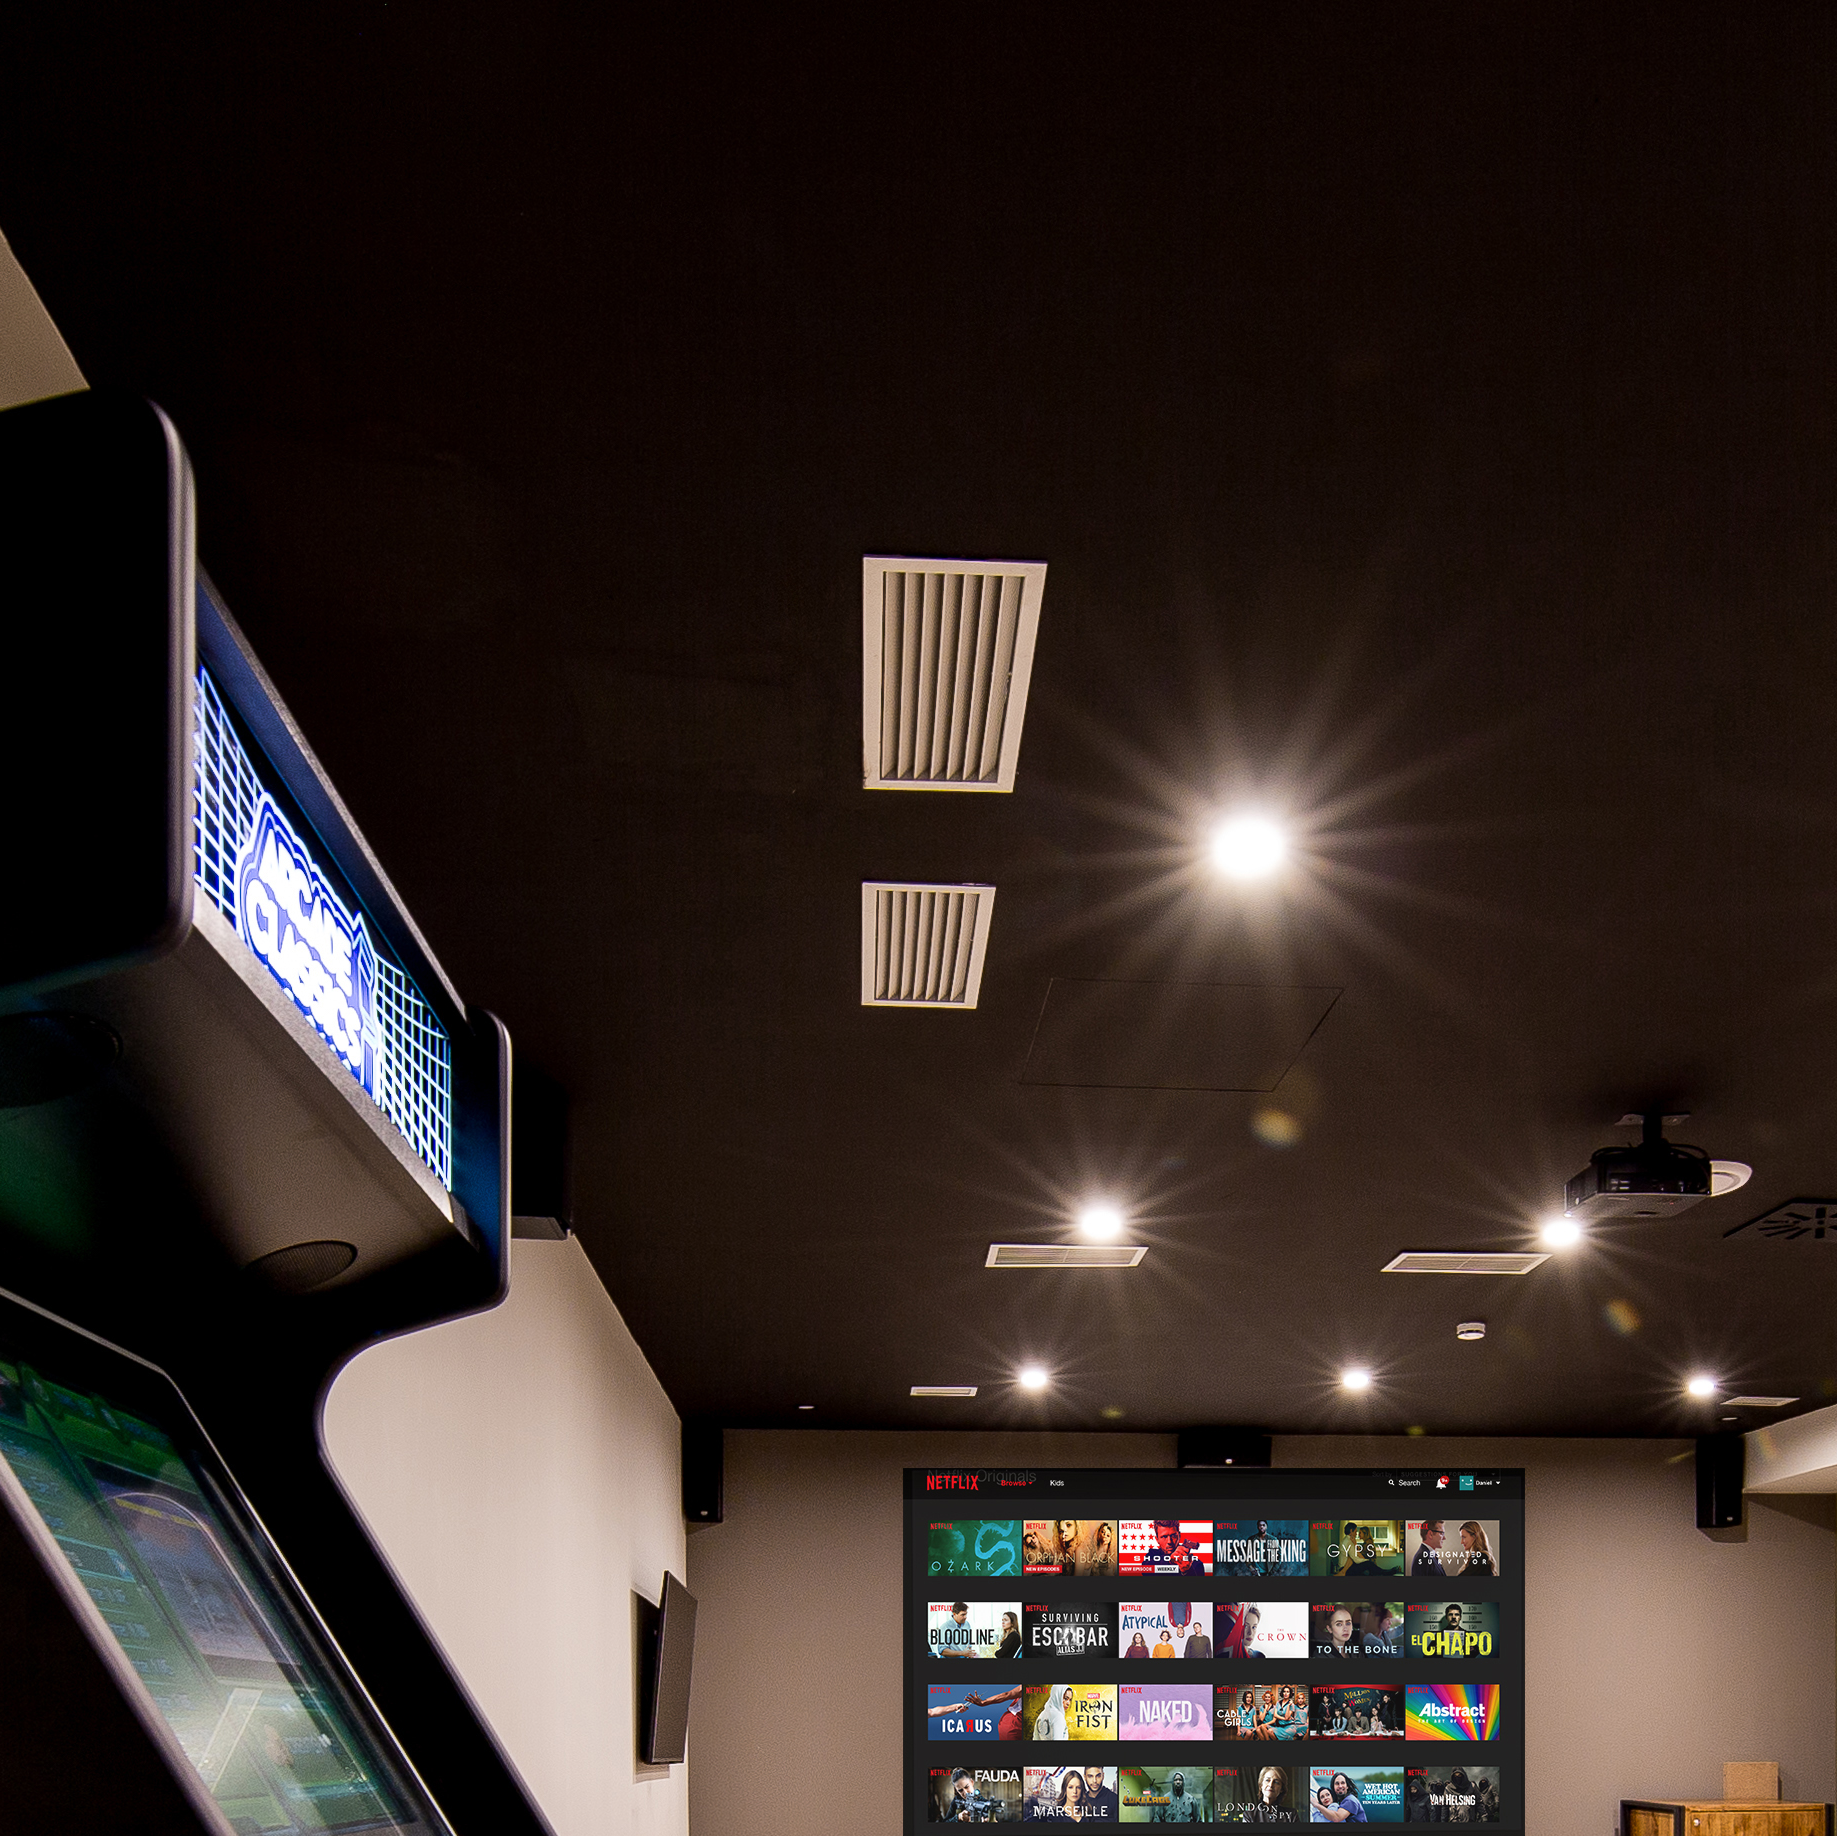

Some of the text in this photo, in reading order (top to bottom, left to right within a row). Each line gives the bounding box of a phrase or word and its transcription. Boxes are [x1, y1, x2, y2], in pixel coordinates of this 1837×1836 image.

[259, 828, 352, 996] ARCADE
[245, 878, 362, 1067] CLASSICS
[927, 1475, 979, 1491] NETFLIX
[930, 1522, 953, 1530] NETFLIX
[1026, 1522, 1046, 1530] NETFLIX
[1121, 1522, 1142, 1530] NETFLIX
[1217, 1522, 1238, 1530] NETFLIX
[1313, 1522, 1334, 1530] NETFLIX
[1408, 1522, 1428, 1530] NETFLIX
[1217, 1540, 1266, 1563] MESSAGE
[1280, 1540, 1306, 1563] KING
[1327, 1544, 1389, 1558] GYPSY
[1026, 1552, 1115, 1564] ORPHAN BLACK
[1267, 1550, 1279, 1563] THE
[930, 1604, 952, 1612] NETFLIX
[1026, 1604, 1048, 1612] NETFLIX
[1121, 1604, 1142, 1612] NETFLIX
[1217, 1604, 1239, 1612] NETFLIX
[1313, 1604, 1335, 1612] NETFLIX
[1408, 1604, 1428, 1612] NETFLIX
[1042, 1614, 1099, 1622] SURVIVING
[1122, 1614, 1168, 1630] ATYPICAL
[930, 1629, 995, 1646] BLOODLINE
[1257, 1633, 1306, 1641] CROWN
[1412, 1631, 1492, 1656] EL CHAPO
[1317, 1646, 1398, 1654] TO THE BONE
[930, 1686, 951, 1694] NETFLIX
[1026, 1686, 1048, 1694] NETFLIX
[1121, 1686, 1142, 1694] NETFLIX
[1217, 1686, 1238, 1694] NETFLIX
[1313, 1686, 1335, 1694] NETFLIX
[1408, 1686, 1428, 1694] NETFLIX
[1075, 1700, 1113, 1713] IRON
[1419, 1703, 1486, 1717] Abstract
[1140, 1700, 1192, 1723] NAKED
[1217, 1710, 1246, 1718] CABLE
[1076, 1715, 1112, 1729] FIST
[1224, 1718, 1252, 1726] GIRLS
[974, 1770, 1020, 1782] FAUDA
[1430, 1794, 1476, 1806] VAN HELSING
[1217, 1802, 1278, 1812] LONDON
[1033, 1805, 1108, 1818] MARSEILLE
